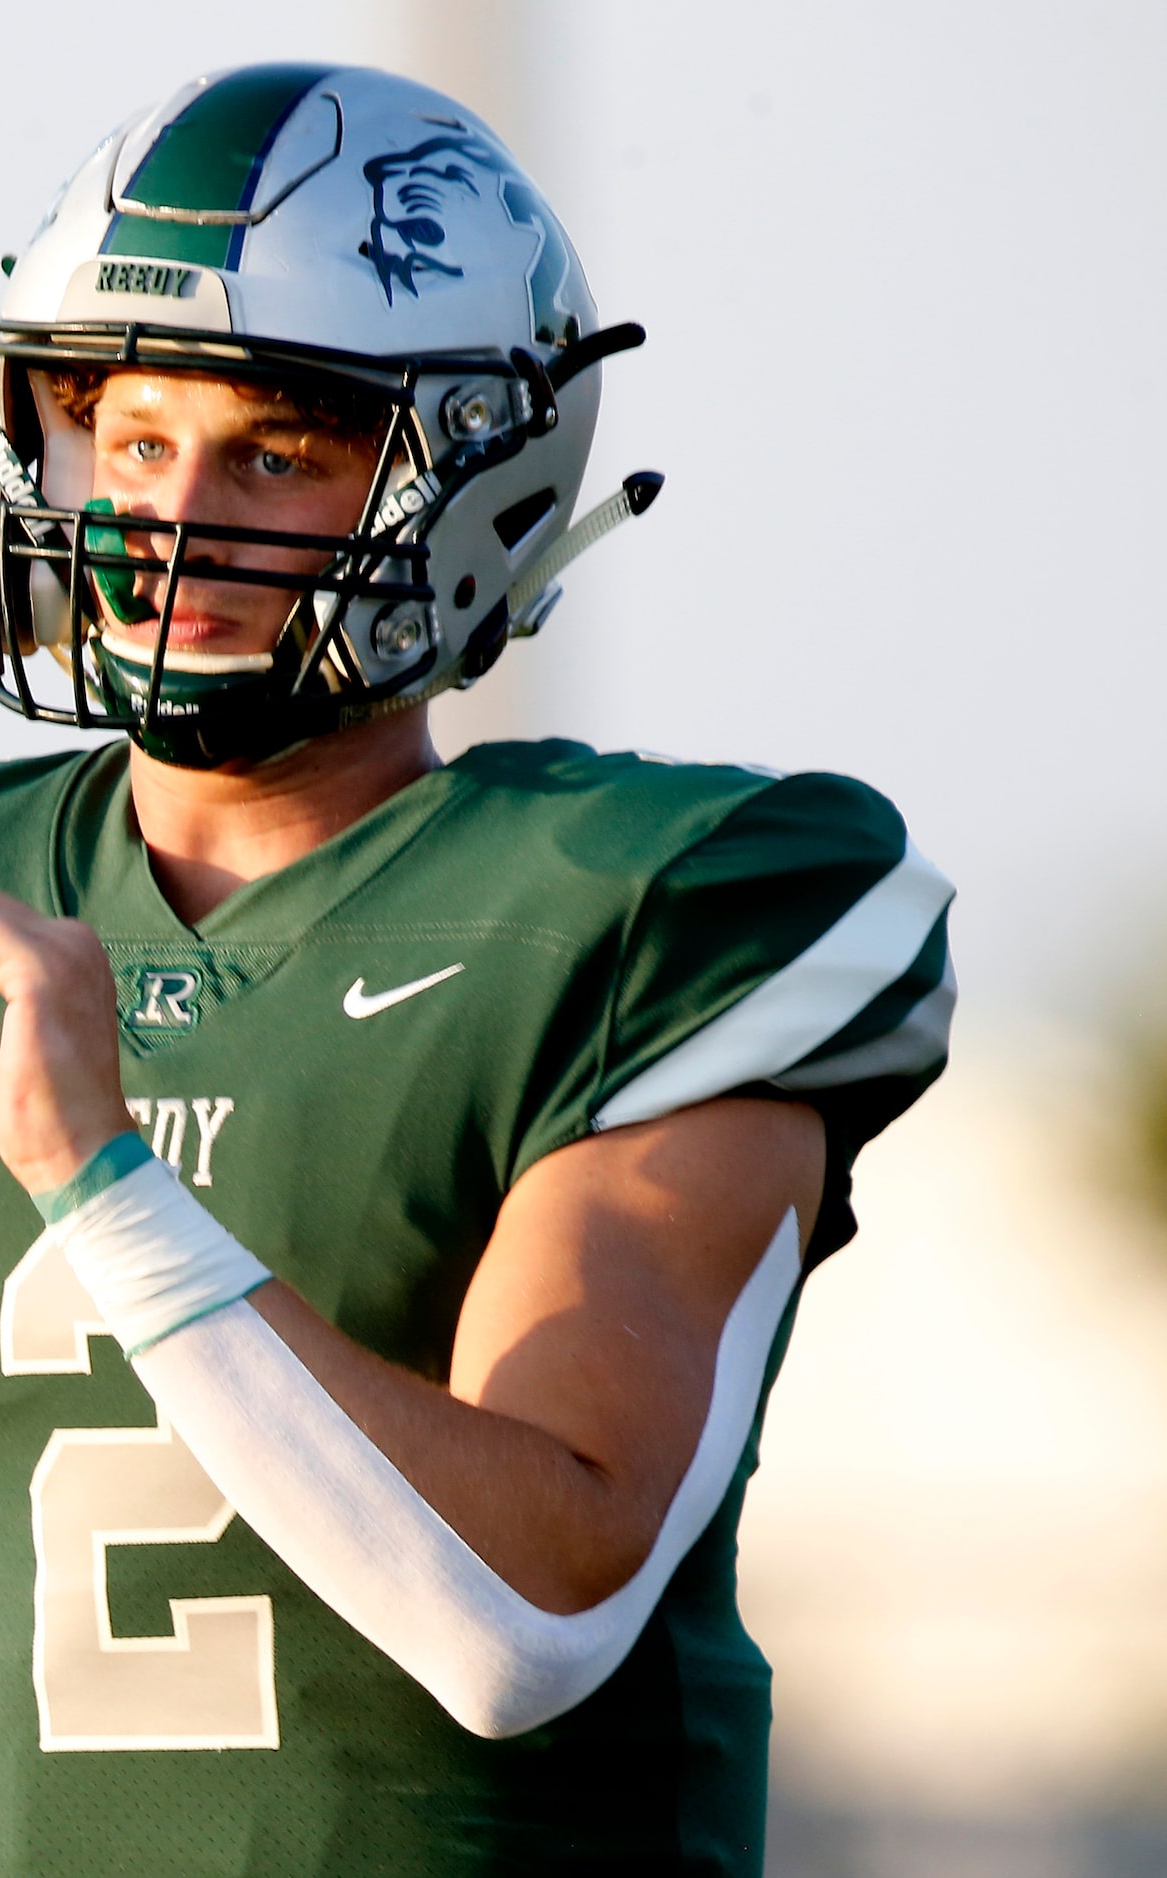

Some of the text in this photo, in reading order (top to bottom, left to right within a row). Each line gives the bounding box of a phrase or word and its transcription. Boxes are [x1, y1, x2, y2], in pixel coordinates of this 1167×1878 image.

[96, 261, 191, 298] REEDY
[132, 968, 197, 1031] R
[0, 1224, 281, 1754] 2
